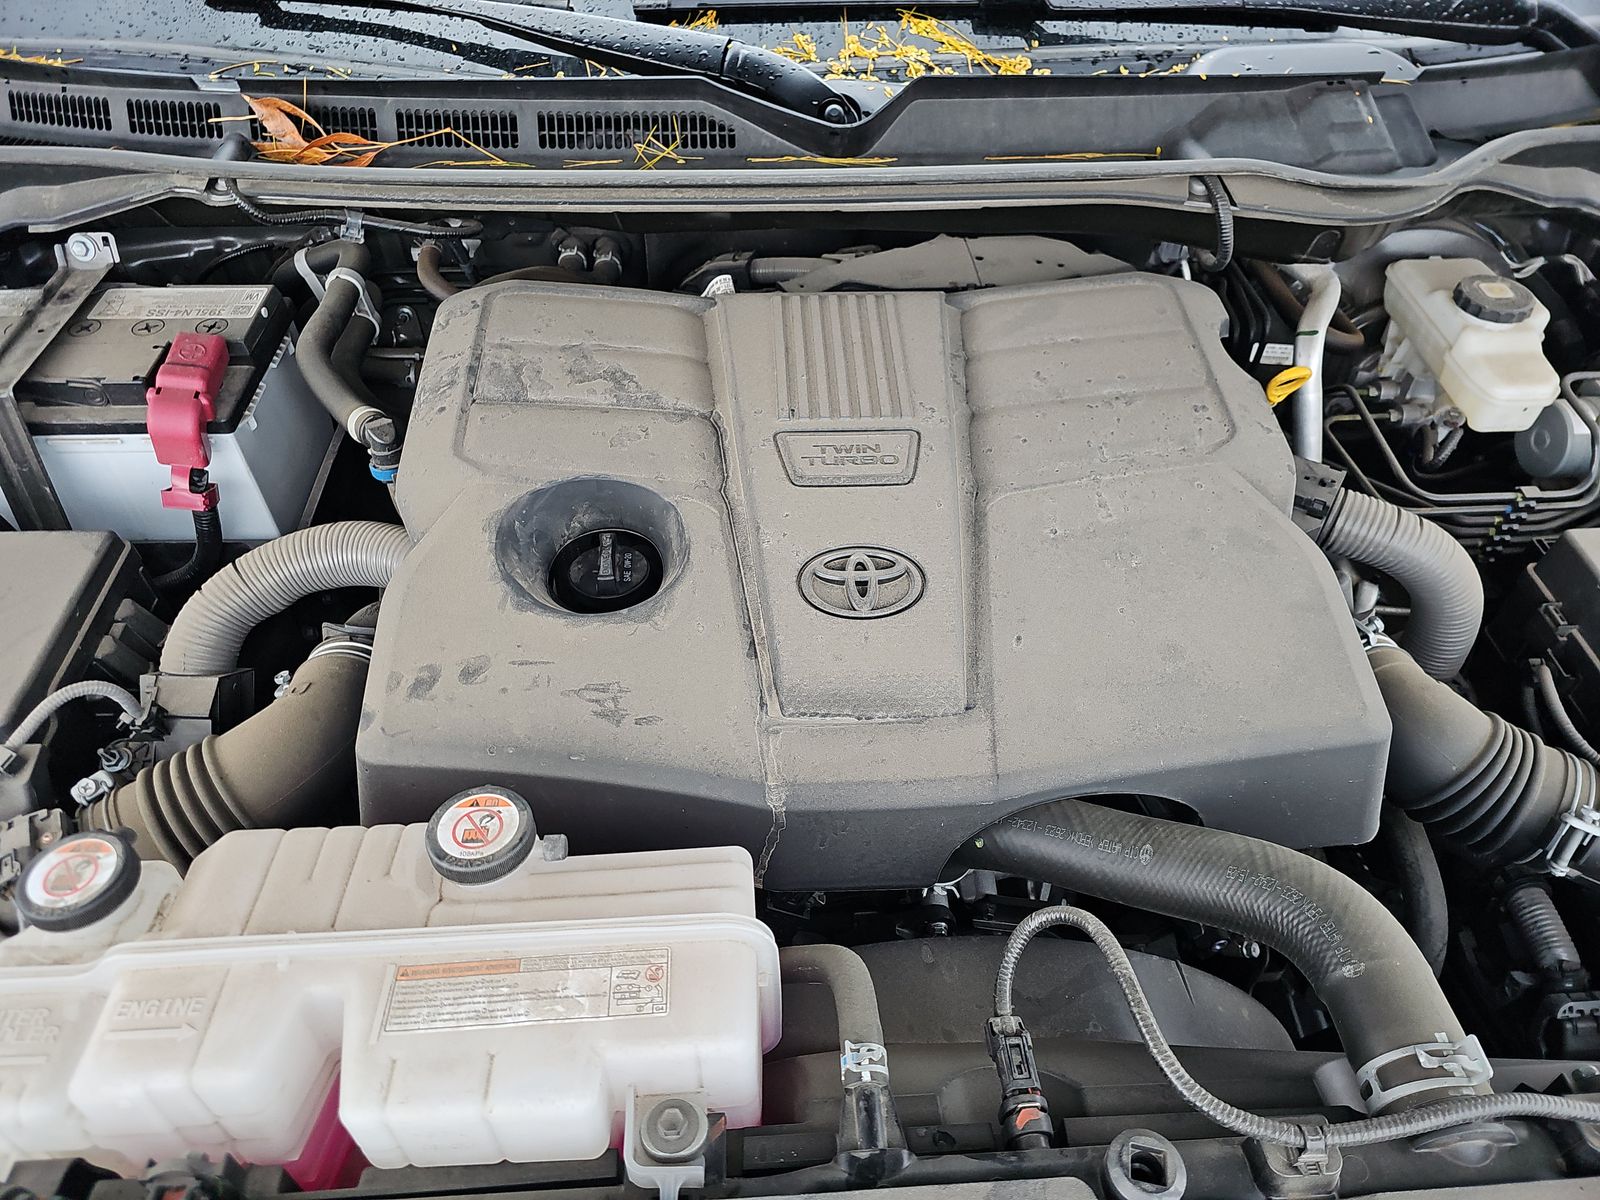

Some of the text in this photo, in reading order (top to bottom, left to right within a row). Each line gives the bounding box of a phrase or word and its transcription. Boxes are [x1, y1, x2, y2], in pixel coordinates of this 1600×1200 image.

[812, 443, 881, 454] TWIN
[801, 454, 900, 466] TURBO
[623, 570, 632, 582] SAE
[112, 996, 208, 1021] ENGINE
